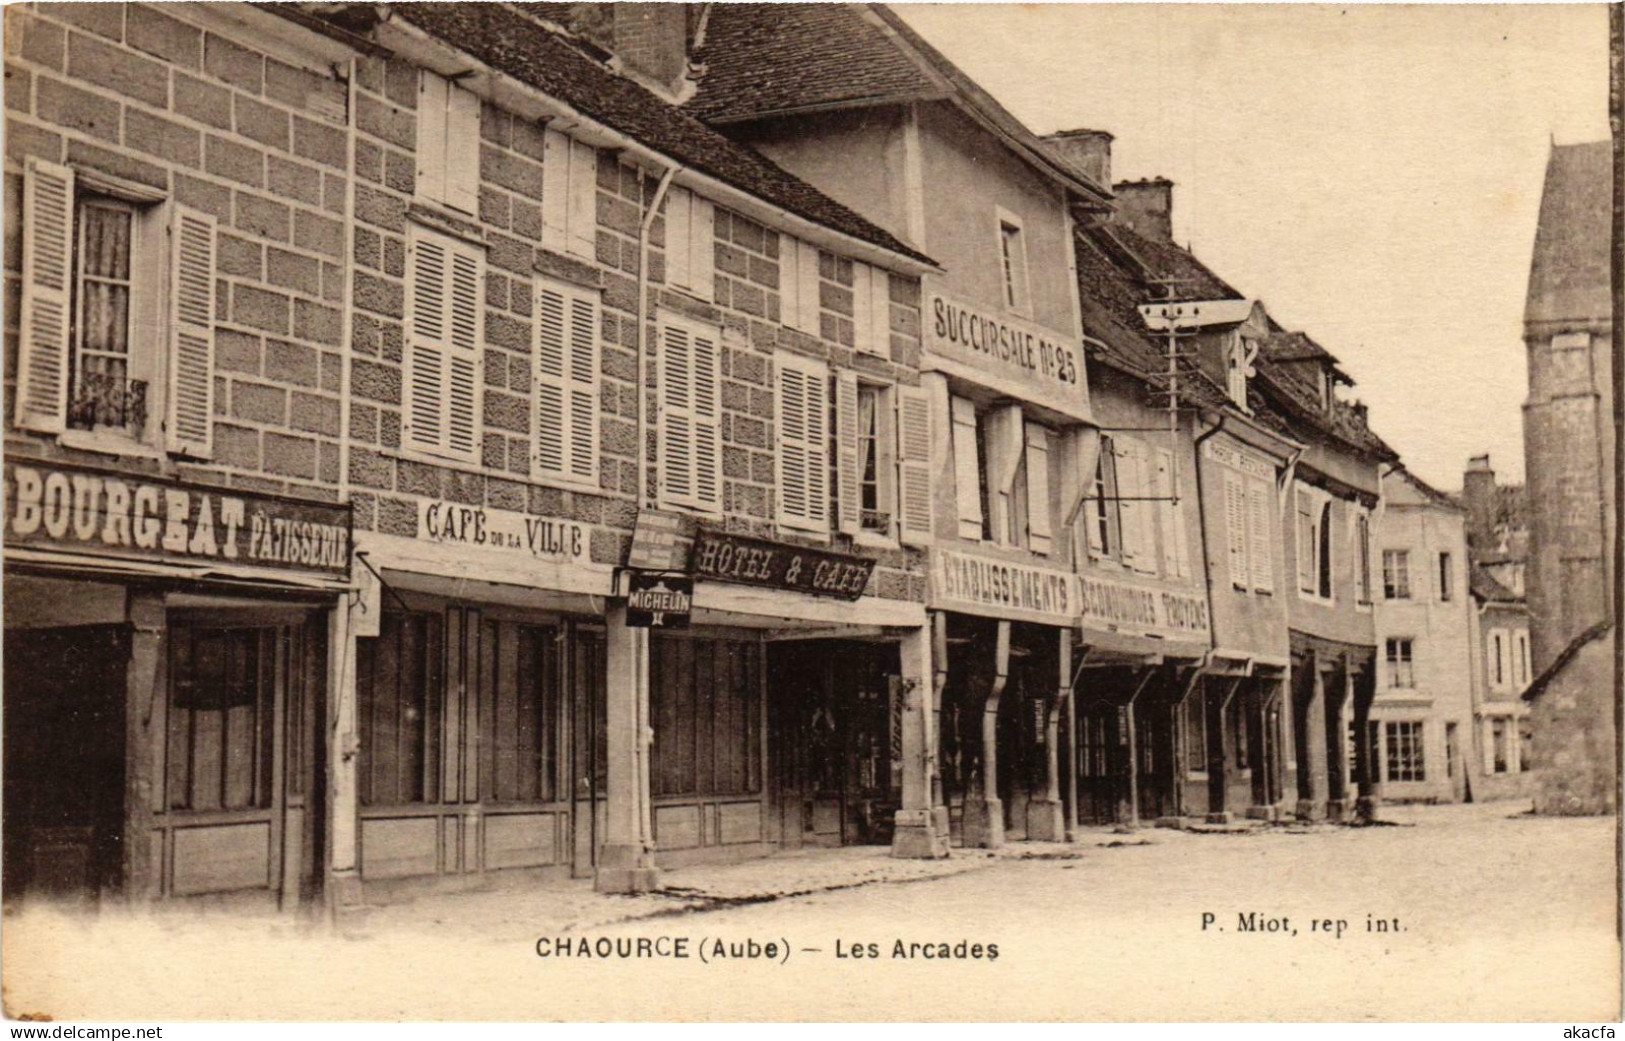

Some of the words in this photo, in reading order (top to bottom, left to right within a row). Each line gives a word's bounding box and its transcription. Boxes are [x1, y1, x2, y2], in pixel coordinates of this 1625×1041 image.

[934, 297, 1036, 370] SUCCURSALE
[1056, 346, 1076, 385] 25
[11, 466, 246, 558] BOURGEAT
[426, 502, 486, 545] CAFÉ
[508, 533, 522, 548] LA
[525, 518, 582, 557] VILLE
[699, 537, 773, 581] HÔTEL
[785, 556, 802, 584] &
[627, 591, 691, 612] MICHELIN
